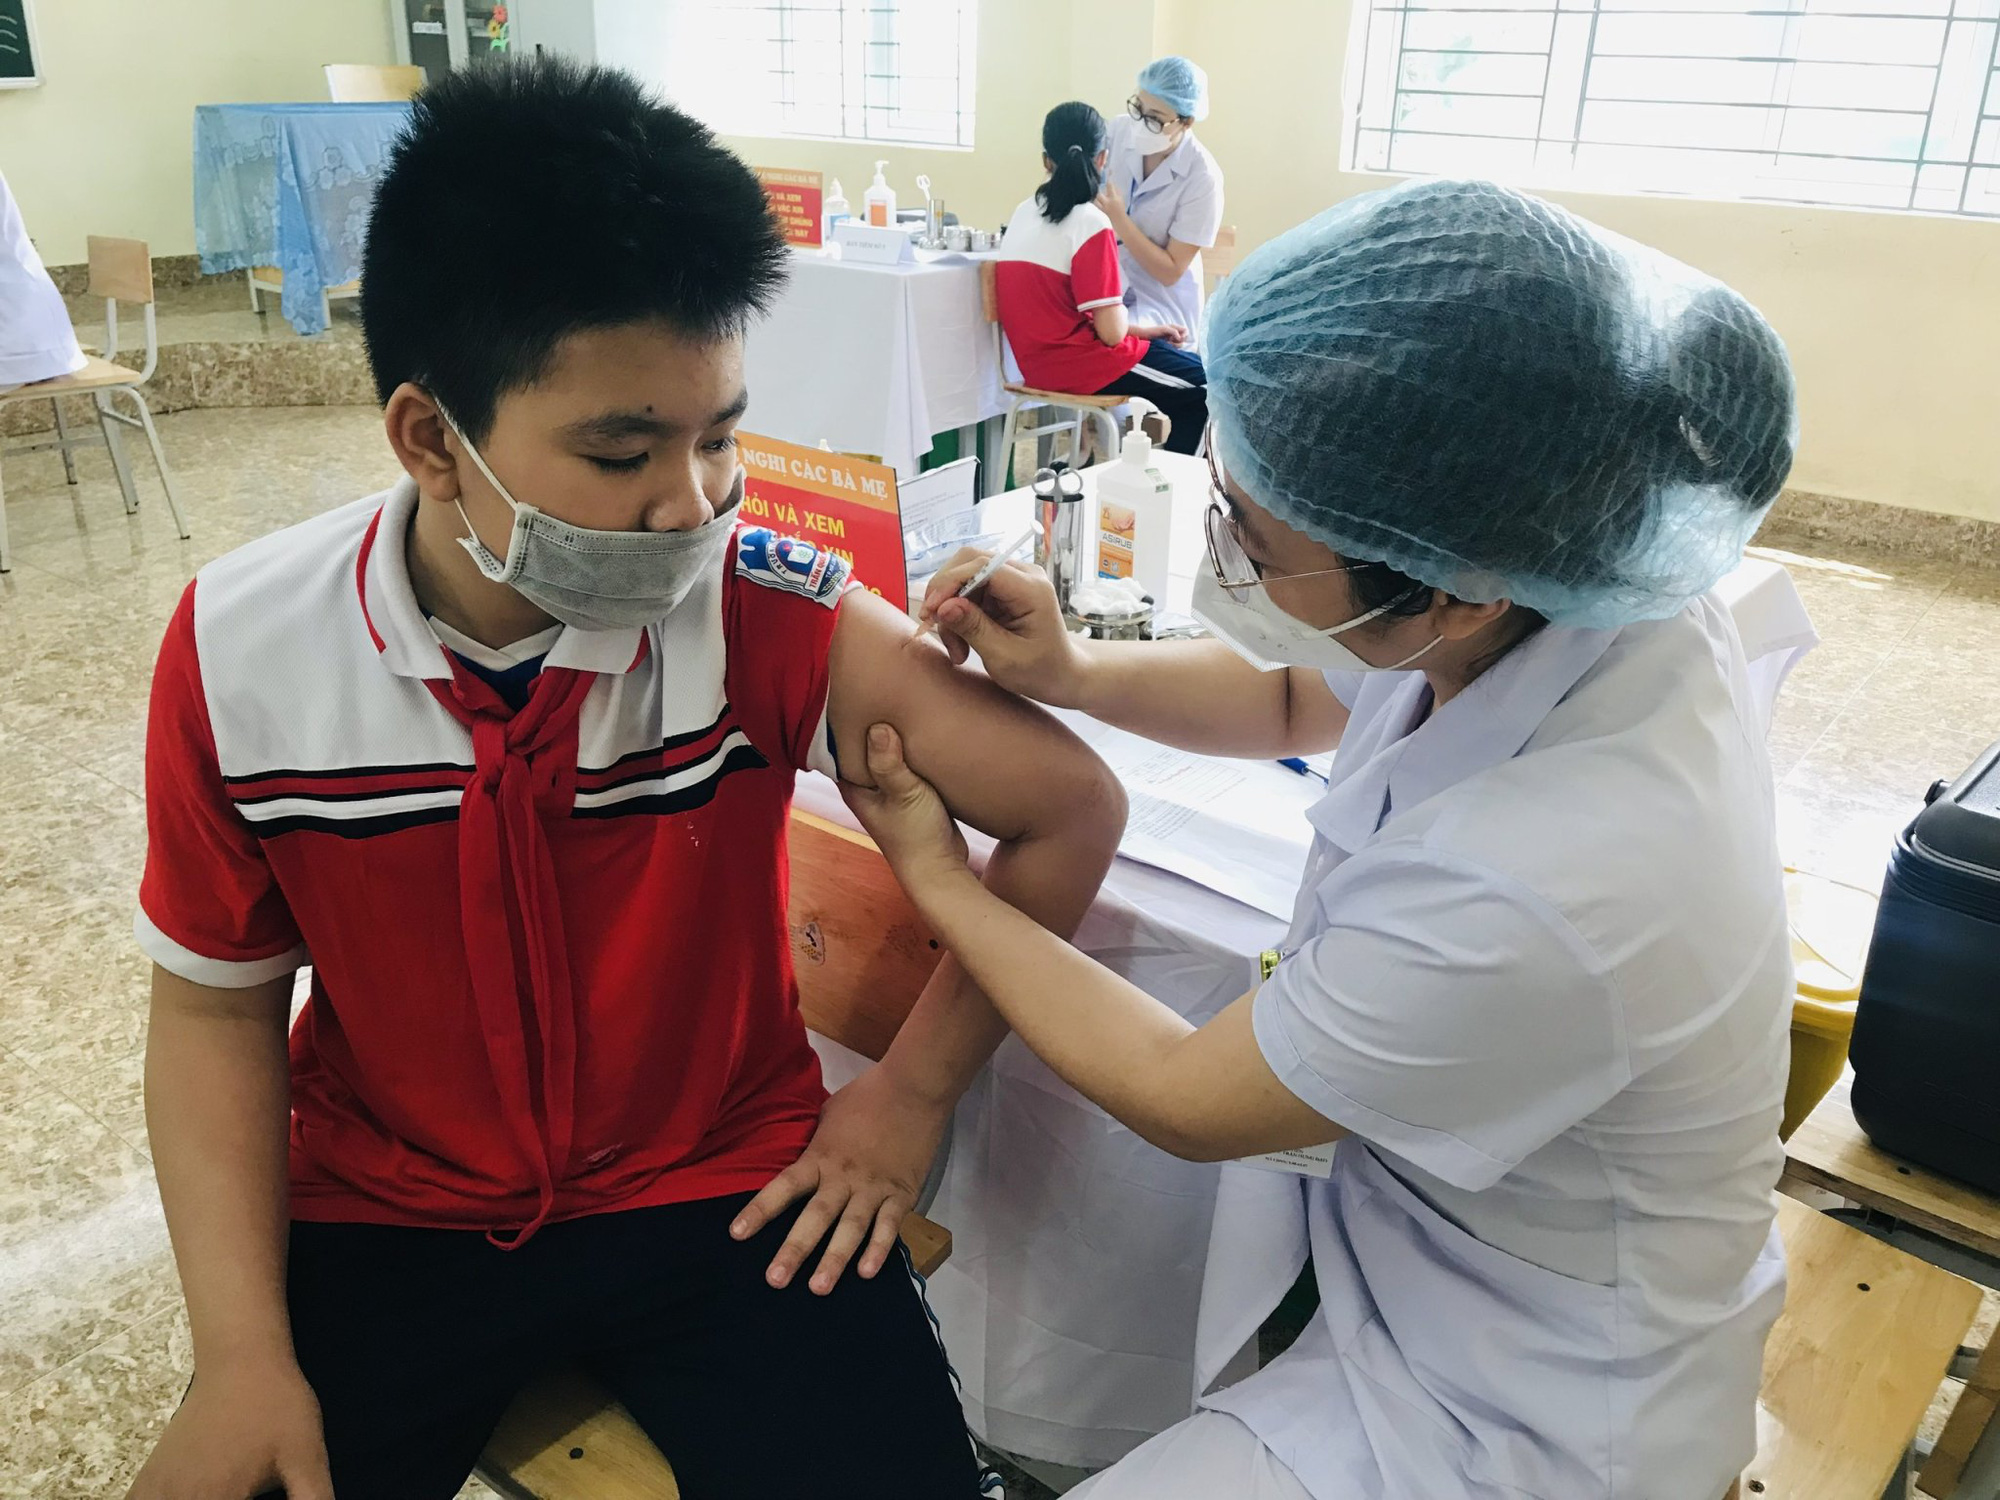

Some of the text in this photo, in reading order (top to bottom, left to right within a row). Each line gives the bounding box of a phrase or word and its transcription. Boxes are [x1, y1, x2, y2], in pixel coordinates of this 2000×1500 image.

[742, 447, 888, 500] NGHỊ CÁC BÀ MẸ
[741, 491, 845, 538] HỎI VÀ XEM
[1102, 533, 1132, 549] ASIRUB
